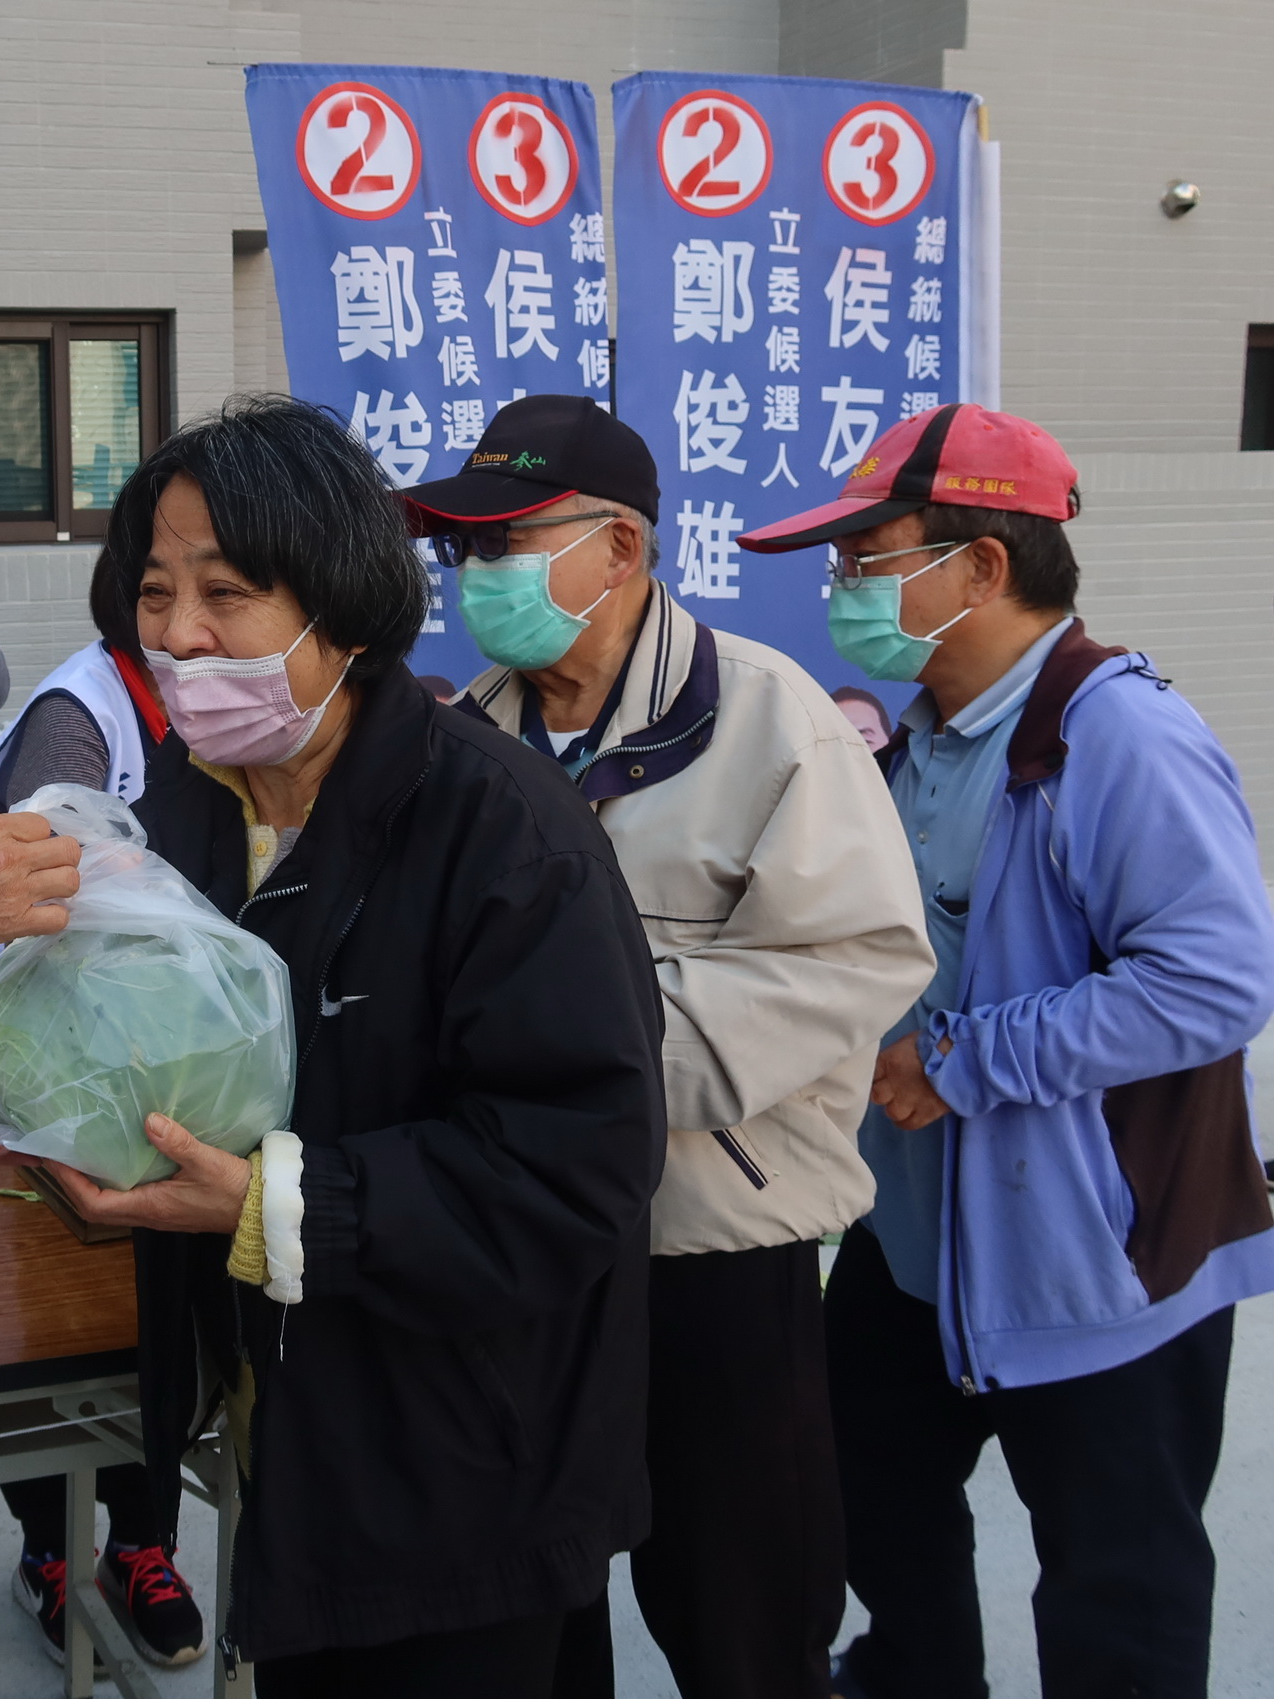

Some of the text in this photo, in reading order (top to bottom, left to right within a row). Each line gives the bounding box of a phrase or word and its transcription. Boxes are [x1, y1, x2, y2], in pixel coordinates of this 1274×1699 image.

[326, 96, 395, 197] 2
[493, 107, 547, 207] 3
[676, 106, 741, 200] 2
[842, 121, 902, 211] 3
[569, 212, 612, 415] 總統候
[760, 207, 801, 489] 立委候選人
[330, 246, 445, 633] 鄭俊
[472, 452, 509, 464] Taiwan
[672, 238, 756, 600] 鄭俊雄
[945, 475, 1018, 496] 服務團隊
